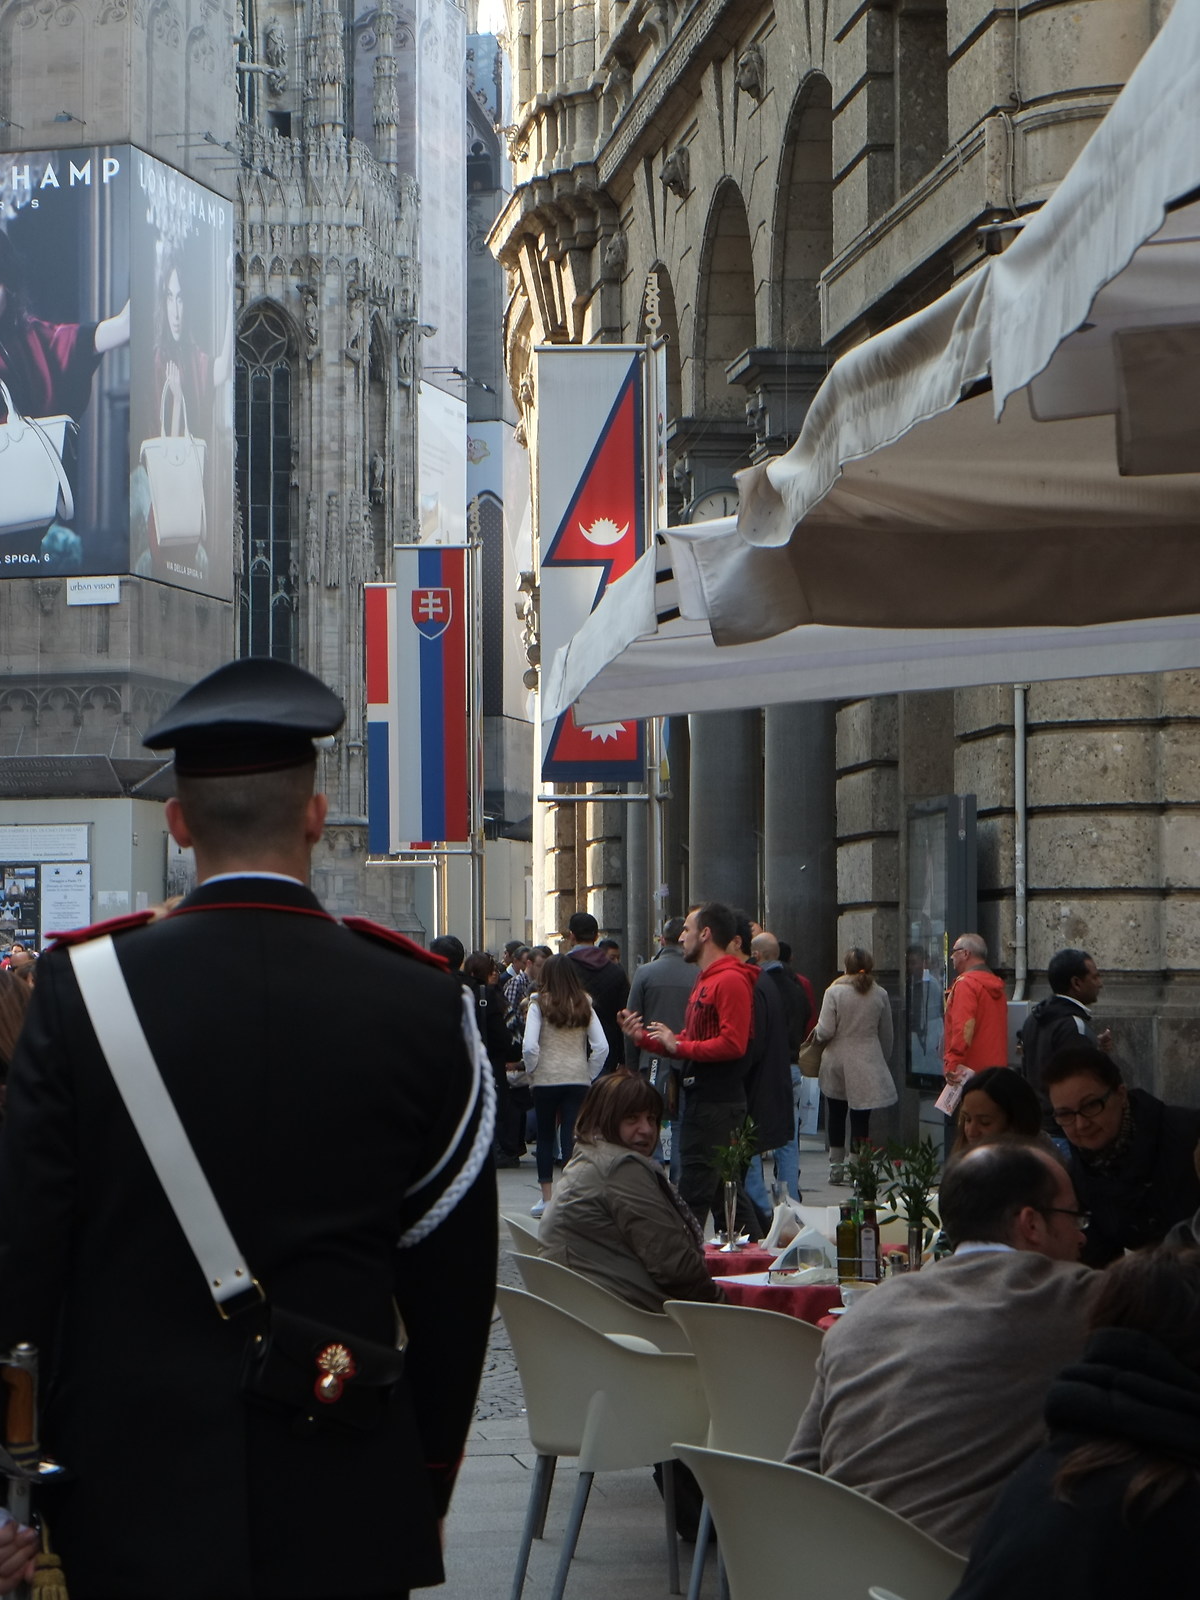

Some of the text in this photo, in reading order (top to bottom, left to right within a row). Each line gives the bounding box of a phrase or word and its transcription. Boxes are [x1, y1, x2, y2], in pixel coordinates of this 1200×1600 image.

[140, 163, 225, 231] LONGCHAMP
[4, 553, 40, 566] SPIGA,
[44, 553, 50, 563] 6
[70, 581, 116, 591] urban vision
